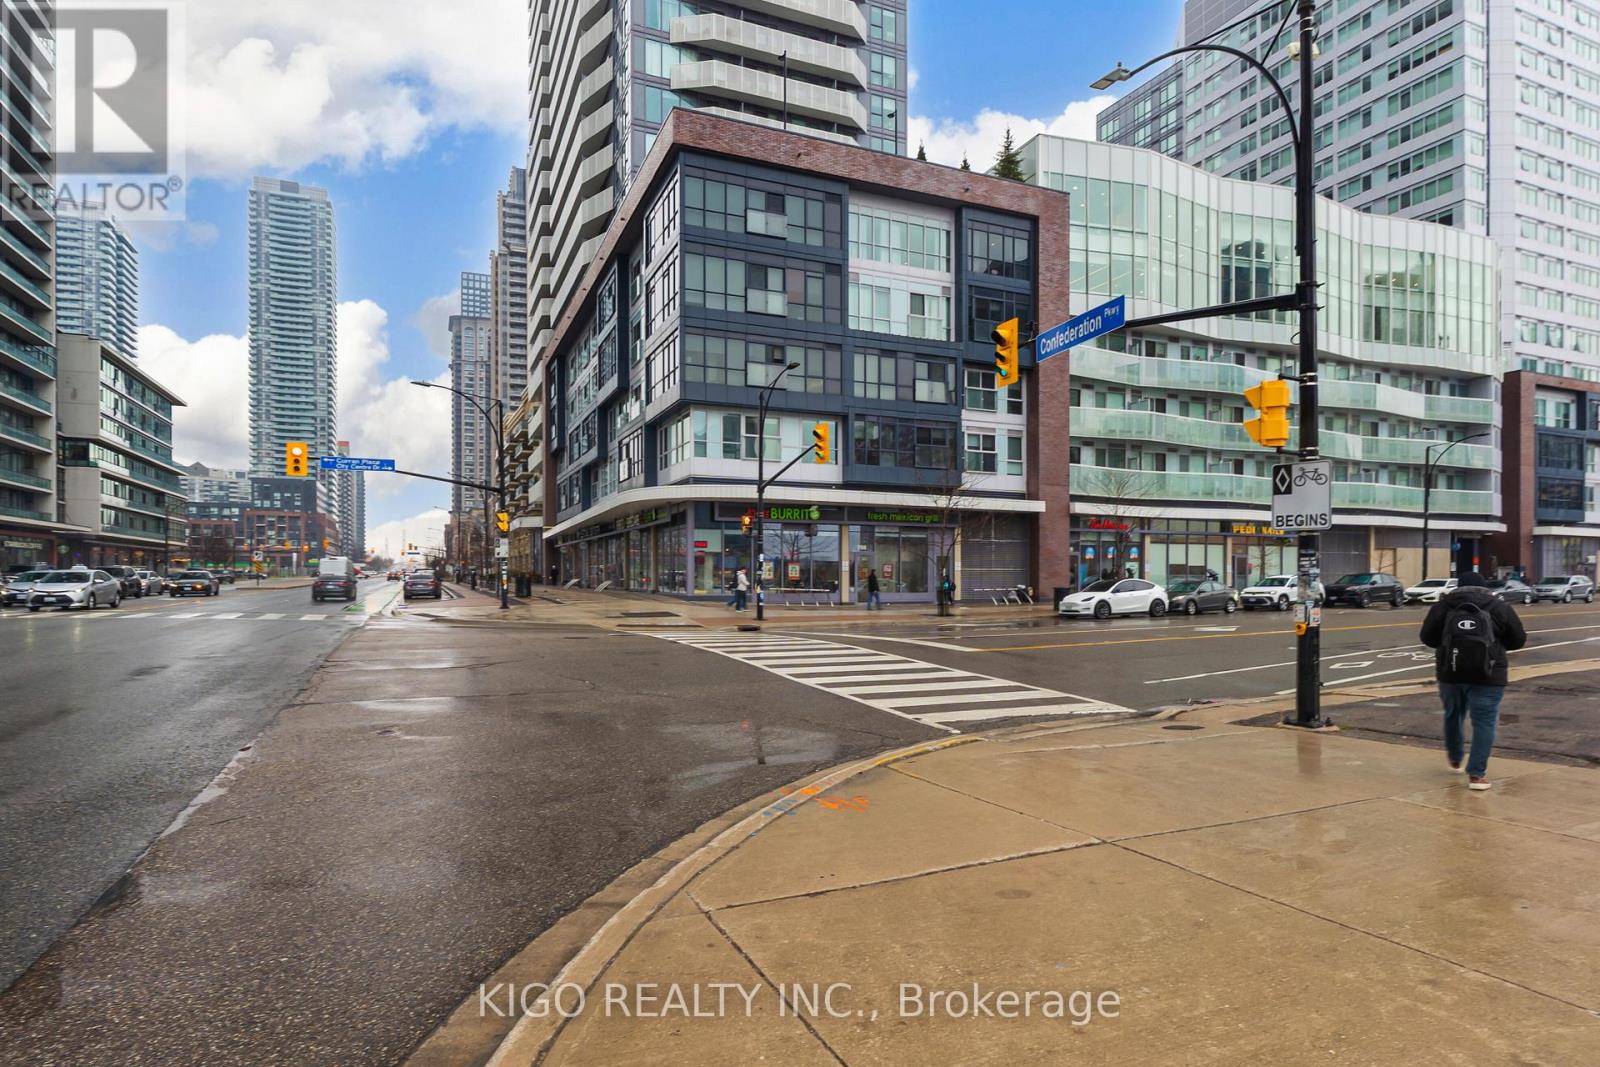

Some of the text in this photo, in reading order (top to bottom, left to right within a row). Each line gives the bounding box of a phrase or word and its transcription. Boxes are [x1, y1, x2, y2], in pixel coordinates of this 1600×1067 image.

[1040, 316, 1101, 354] Confederation
[867, 511, 888, 521] fresh
[1275, 513, 1328, 528] BEGINS
[1232, 525, 1256, 534] PEDI
